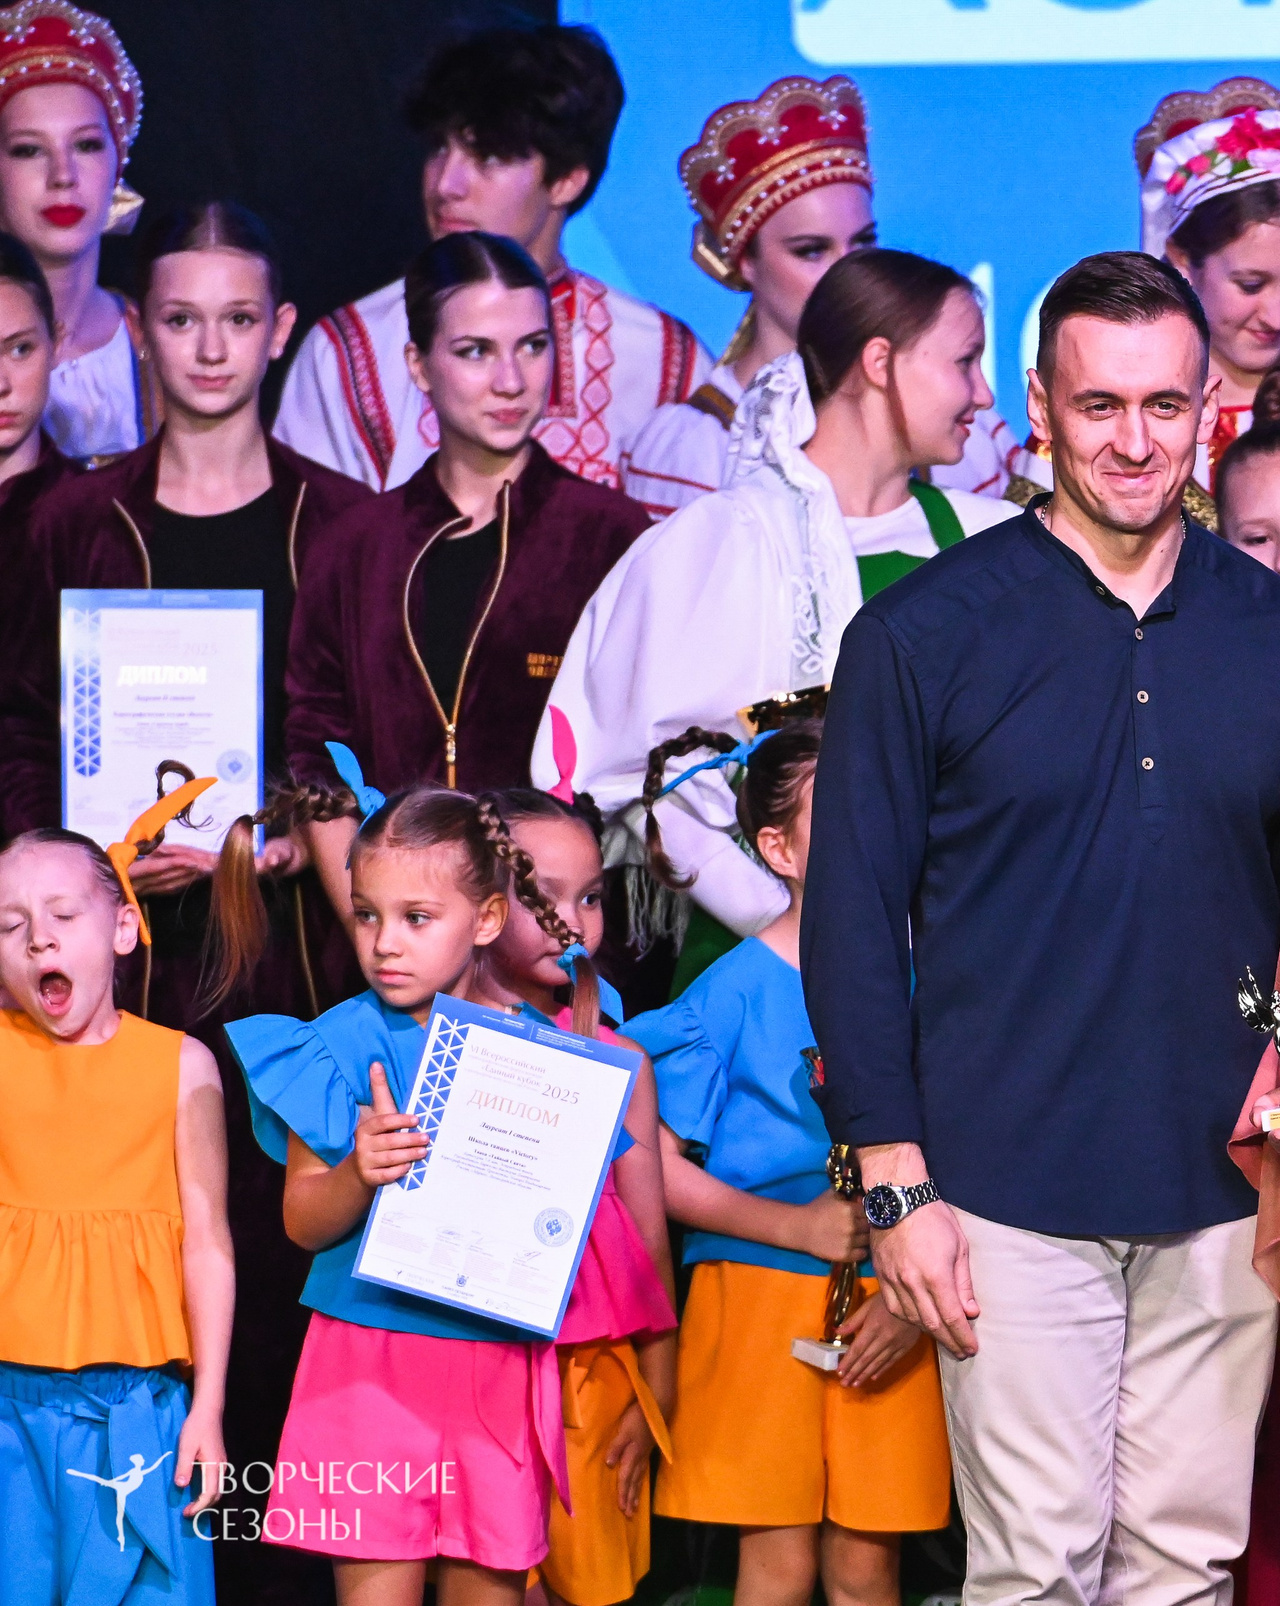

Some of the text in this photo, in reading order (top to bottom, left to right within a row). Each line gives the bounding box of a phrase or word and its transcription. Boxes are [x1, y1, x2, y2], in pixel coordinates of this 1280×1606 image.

[117, 665, 207, 686] ДИПЛОМ
[541, 1083, 580, 1105] 2025
[467, 1088, 561, 1128] ДИПЛОМ
[480, 1122, 508, 1134] Лауреат
